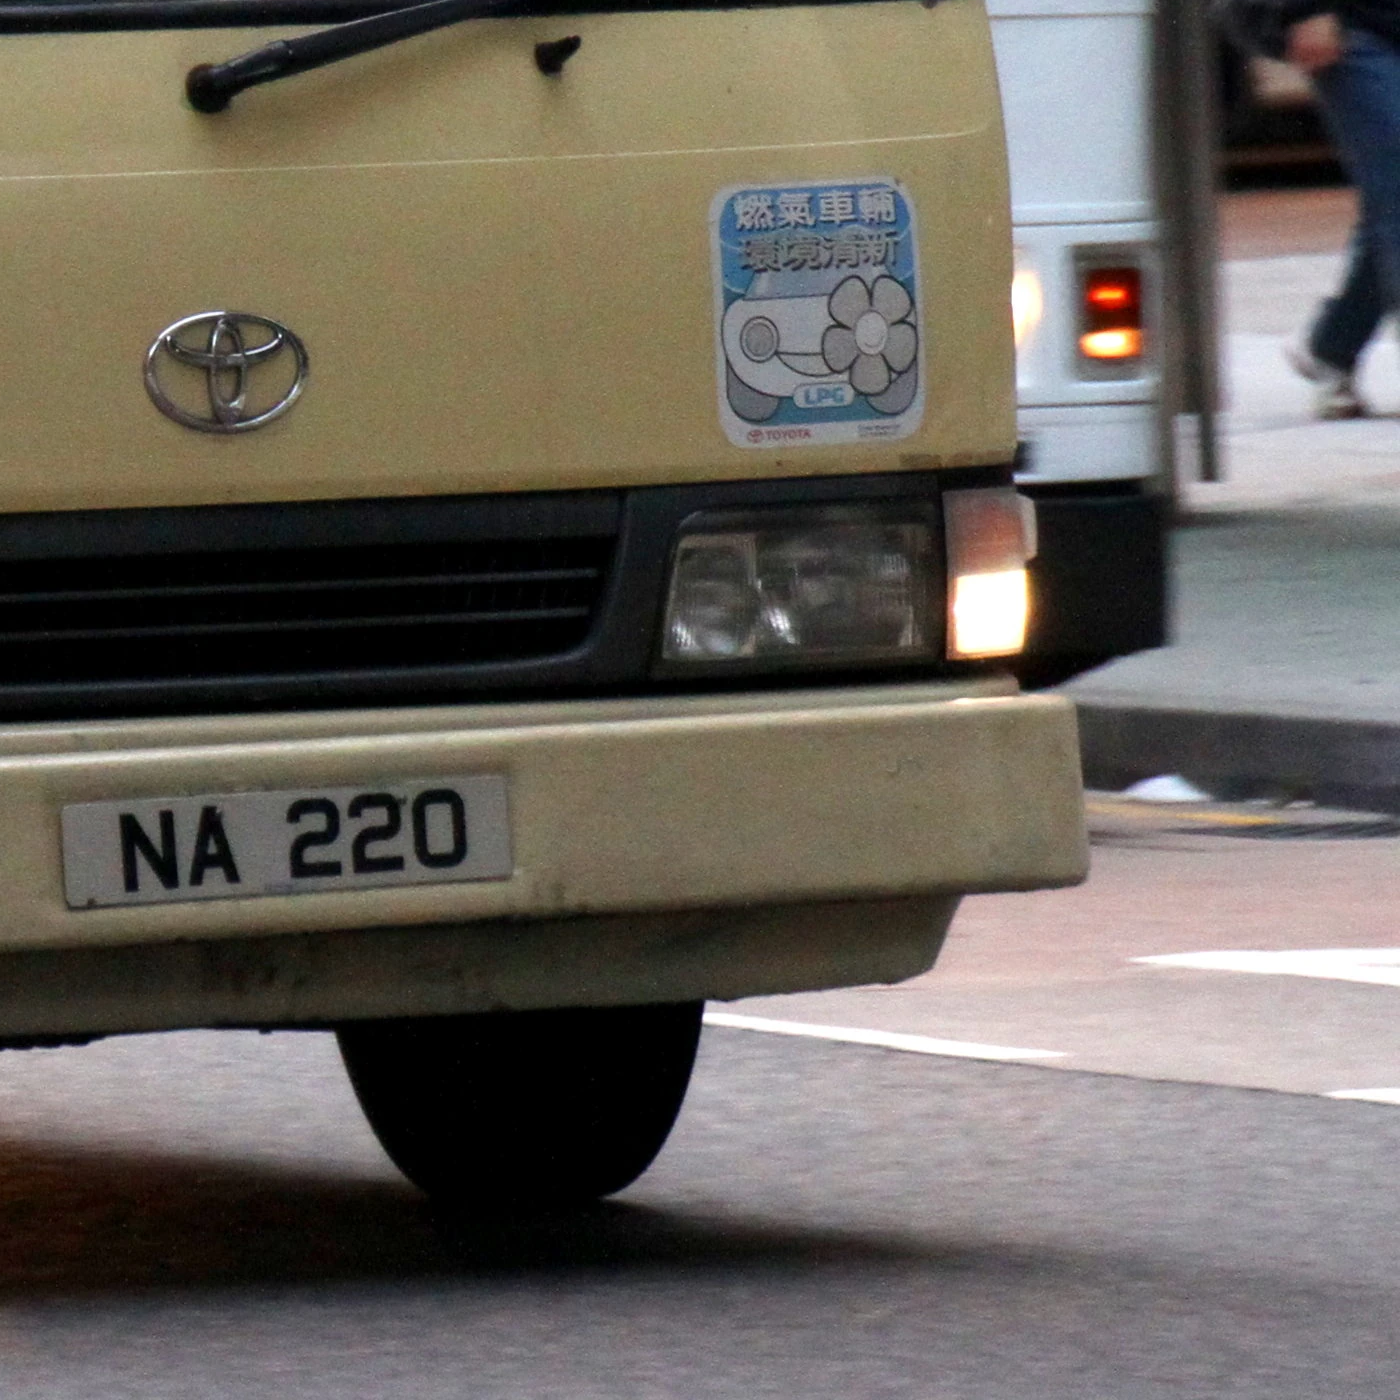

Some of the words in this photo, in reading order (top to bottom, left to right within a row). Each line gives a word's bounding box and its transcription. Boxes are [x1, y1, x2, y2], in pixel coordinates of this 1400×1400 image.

[803, 389, 845, 405] LPG
[765, 428, 812, 440] TOYOTA
[119, 805, 241, 893] NA
[286, 788, 466, 879] 220
